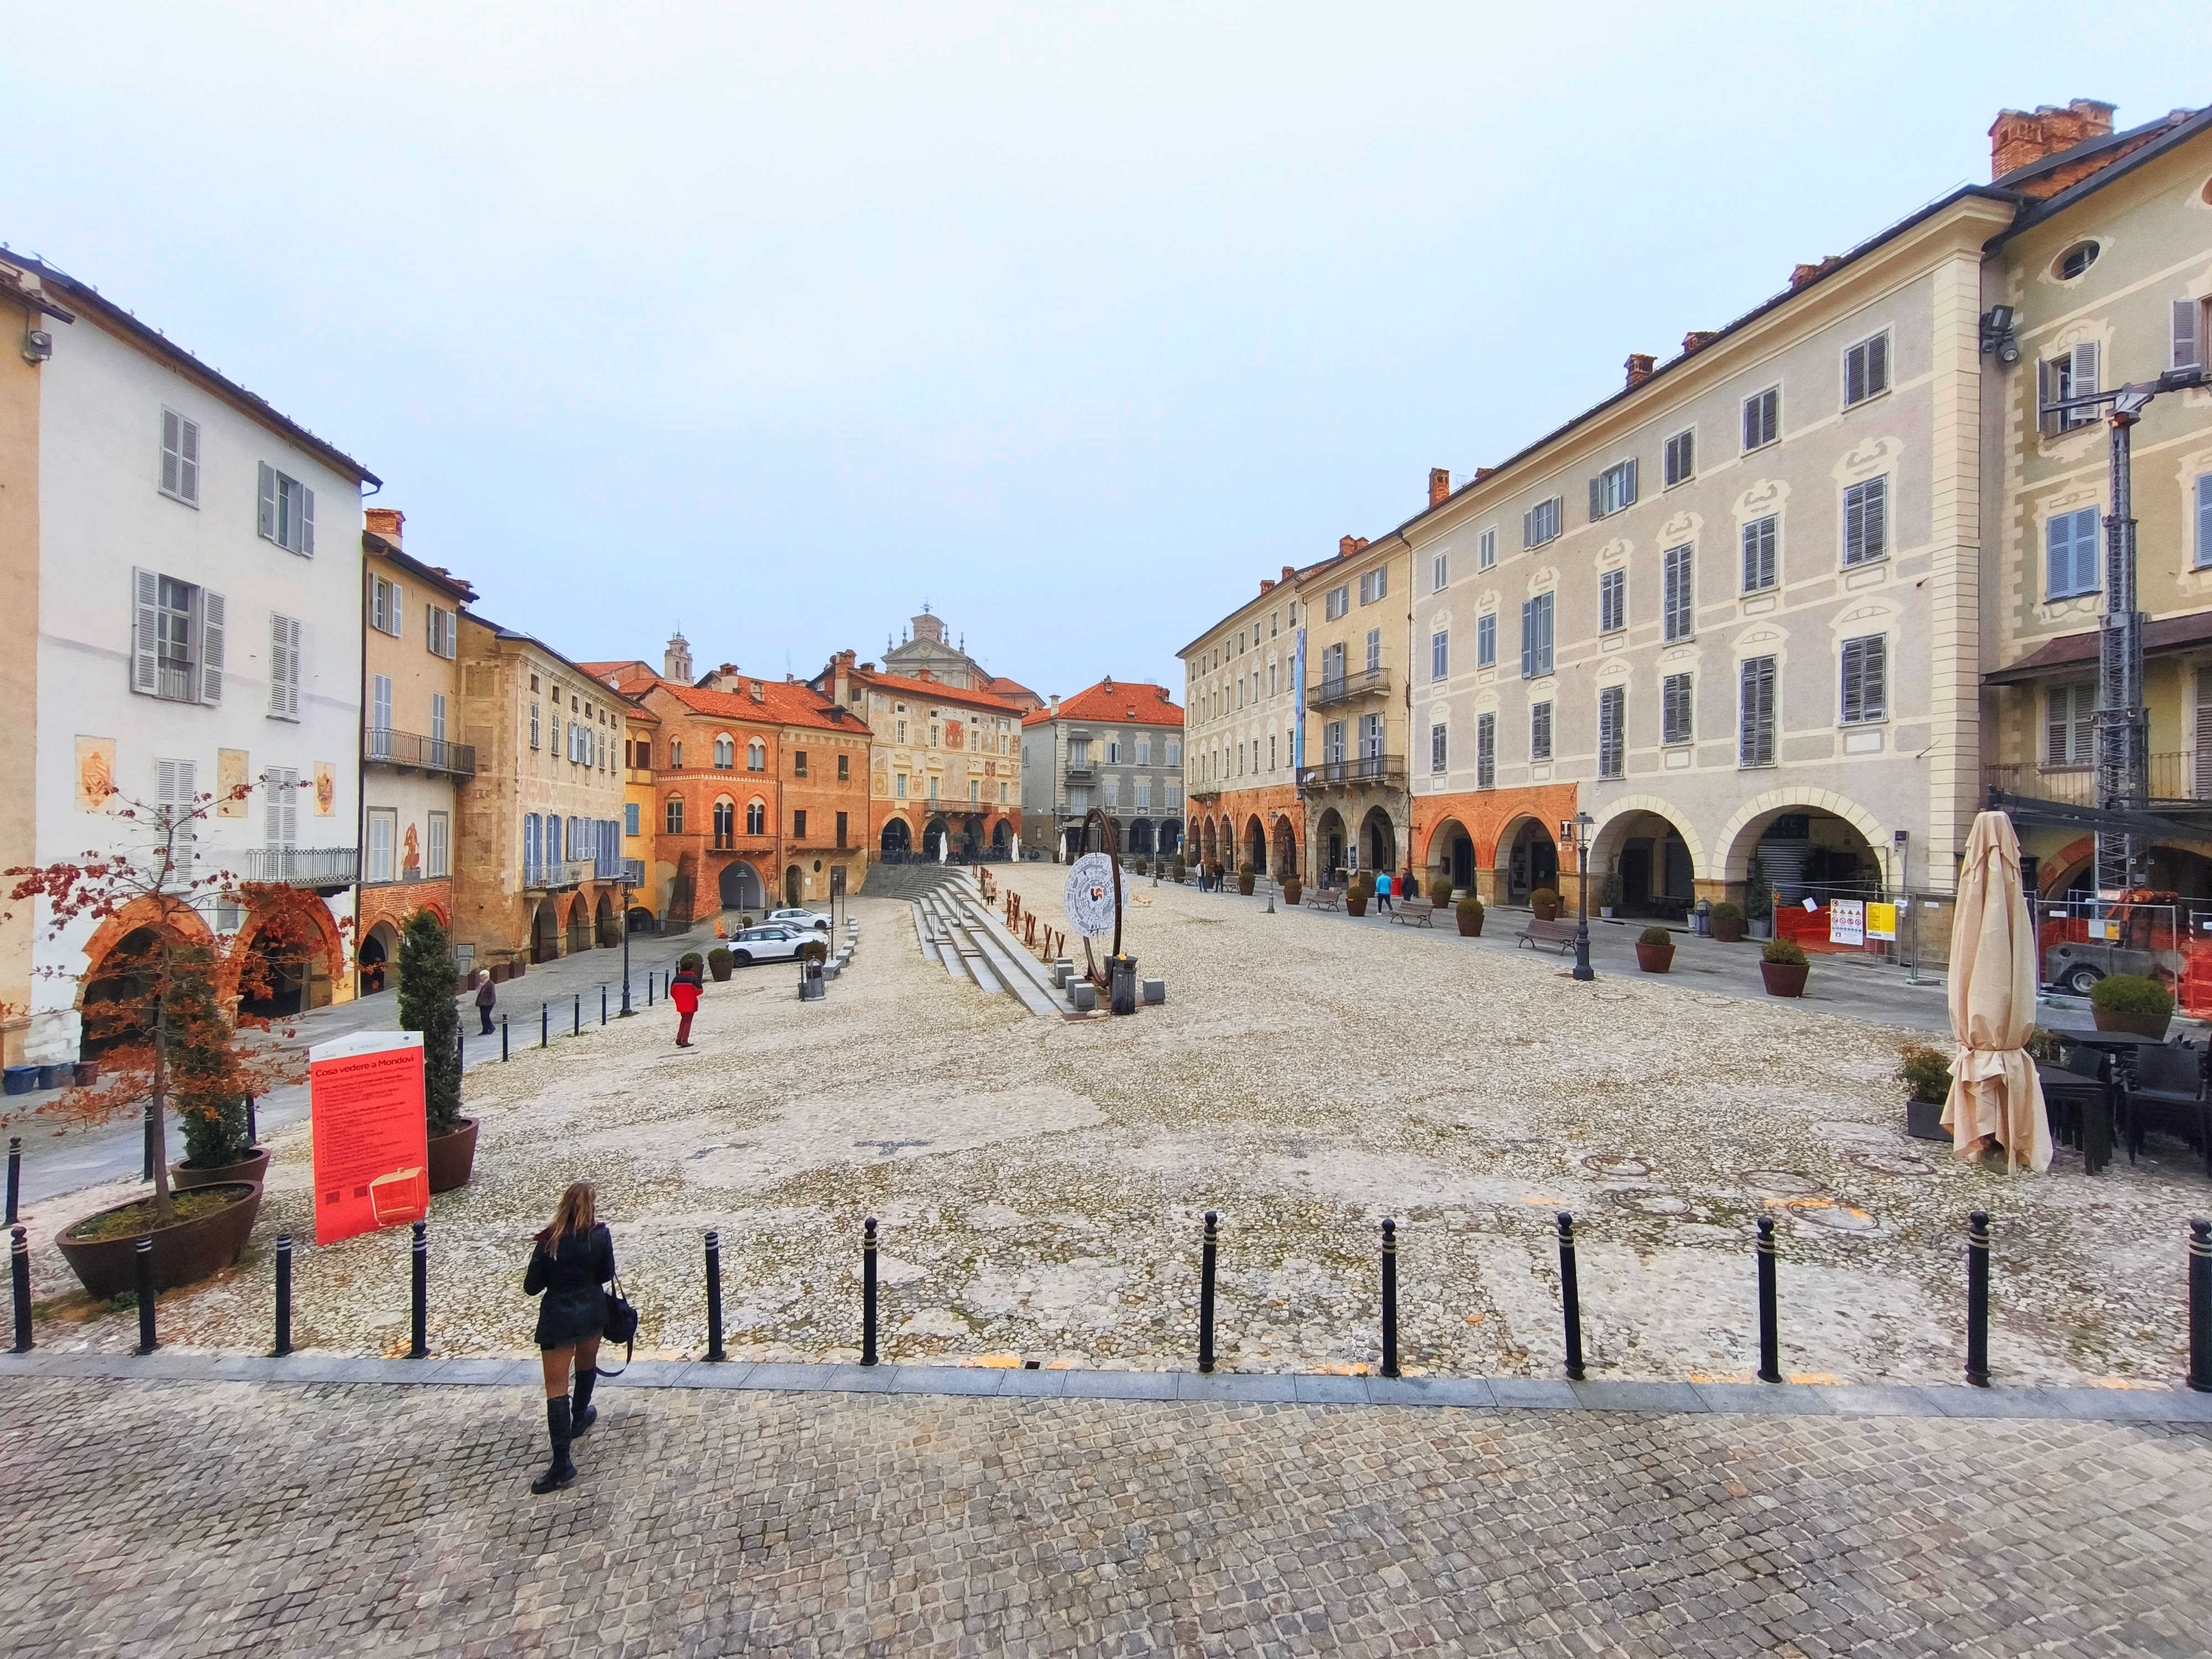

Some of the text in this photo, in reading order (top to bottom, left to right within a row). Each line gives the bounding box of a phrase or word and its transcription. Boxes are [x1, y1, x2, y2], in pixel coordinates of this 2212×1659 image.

[315, 1068, 338, 1077] Cosa
[340, 1062, 369, 1073] vedere
[378, 1055, 414, 1067] Mondovì
